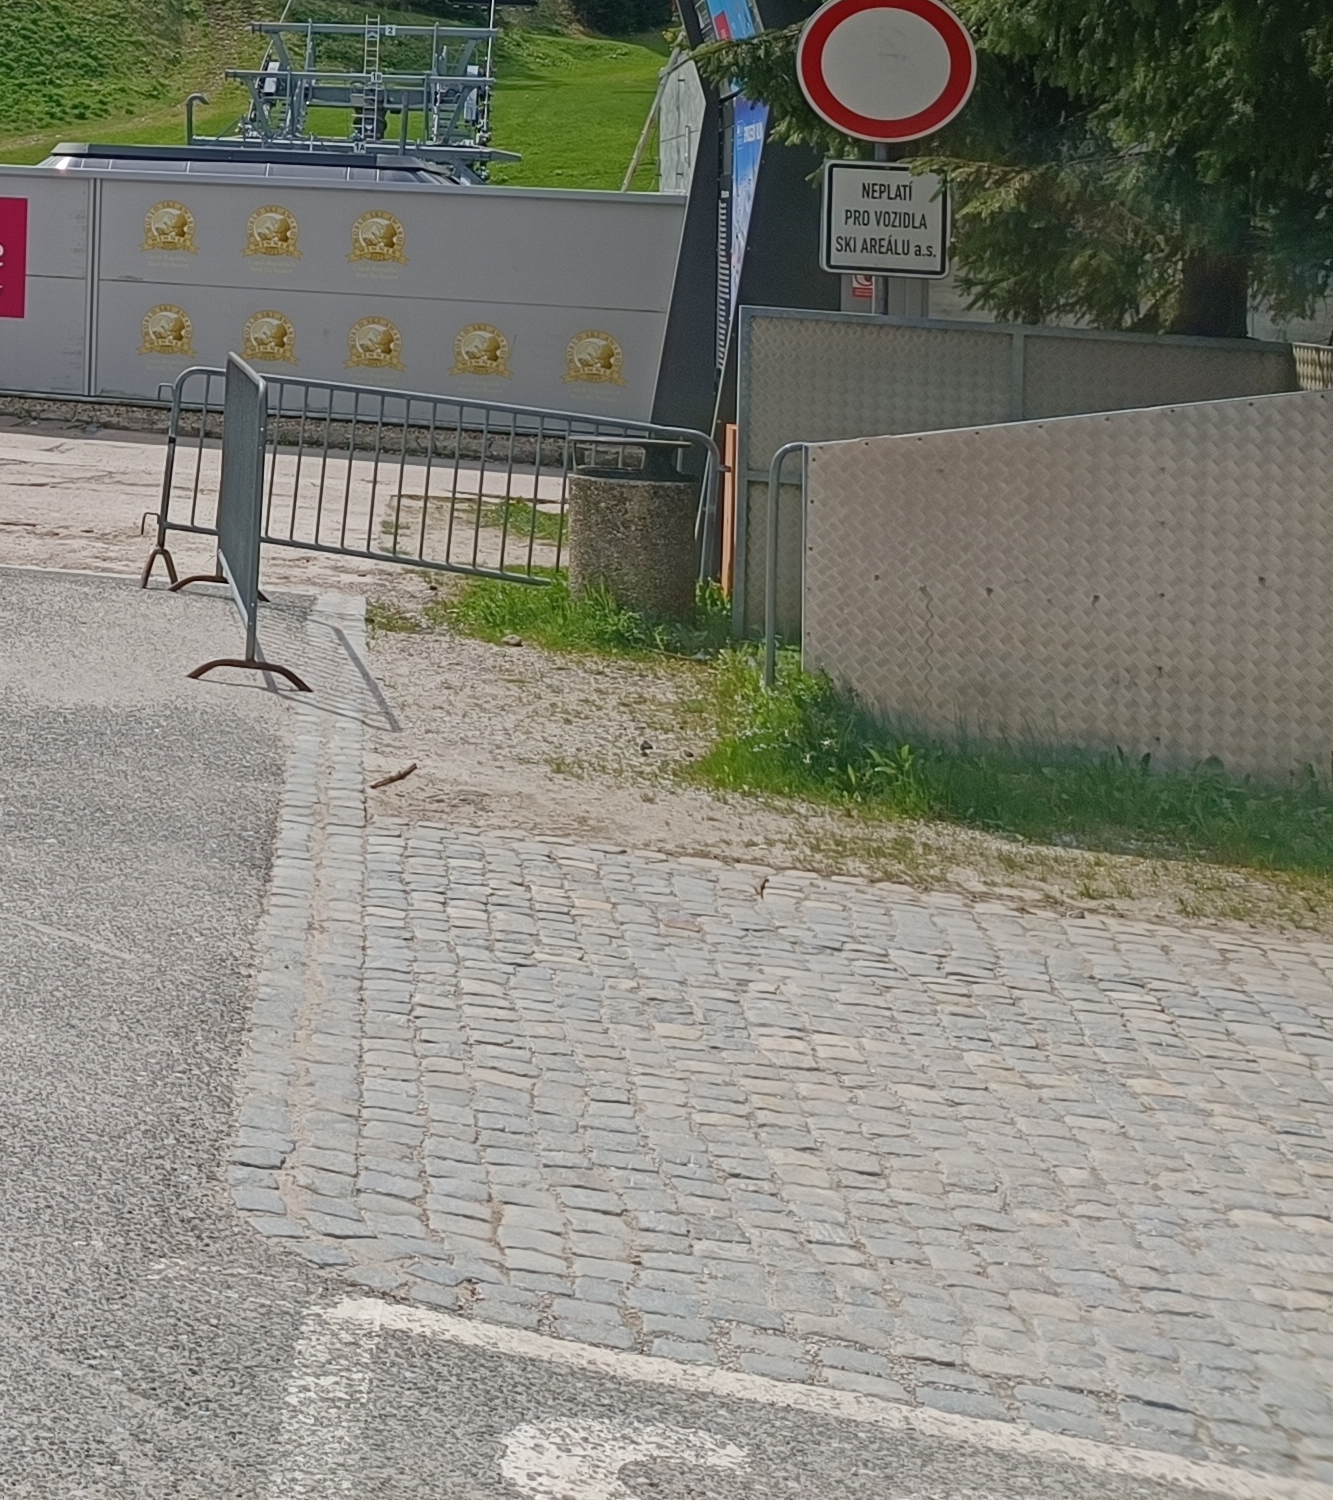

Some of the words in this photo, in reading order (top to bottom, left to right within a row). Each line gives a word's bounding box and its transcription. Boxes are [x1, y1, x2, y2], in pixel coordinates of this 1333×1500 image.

[354, 143, 365, 152] 1A
[861, 180, 913, 201] NEPLATÍ
[844, 209, 870, 226] PRO
[874, 210, 928, 230] VOZIDLA
[835, 235, 856, 253] SKI
[860, 234, 910, 256] AREÁLU
[914, 244, 936, 258] a.s.
